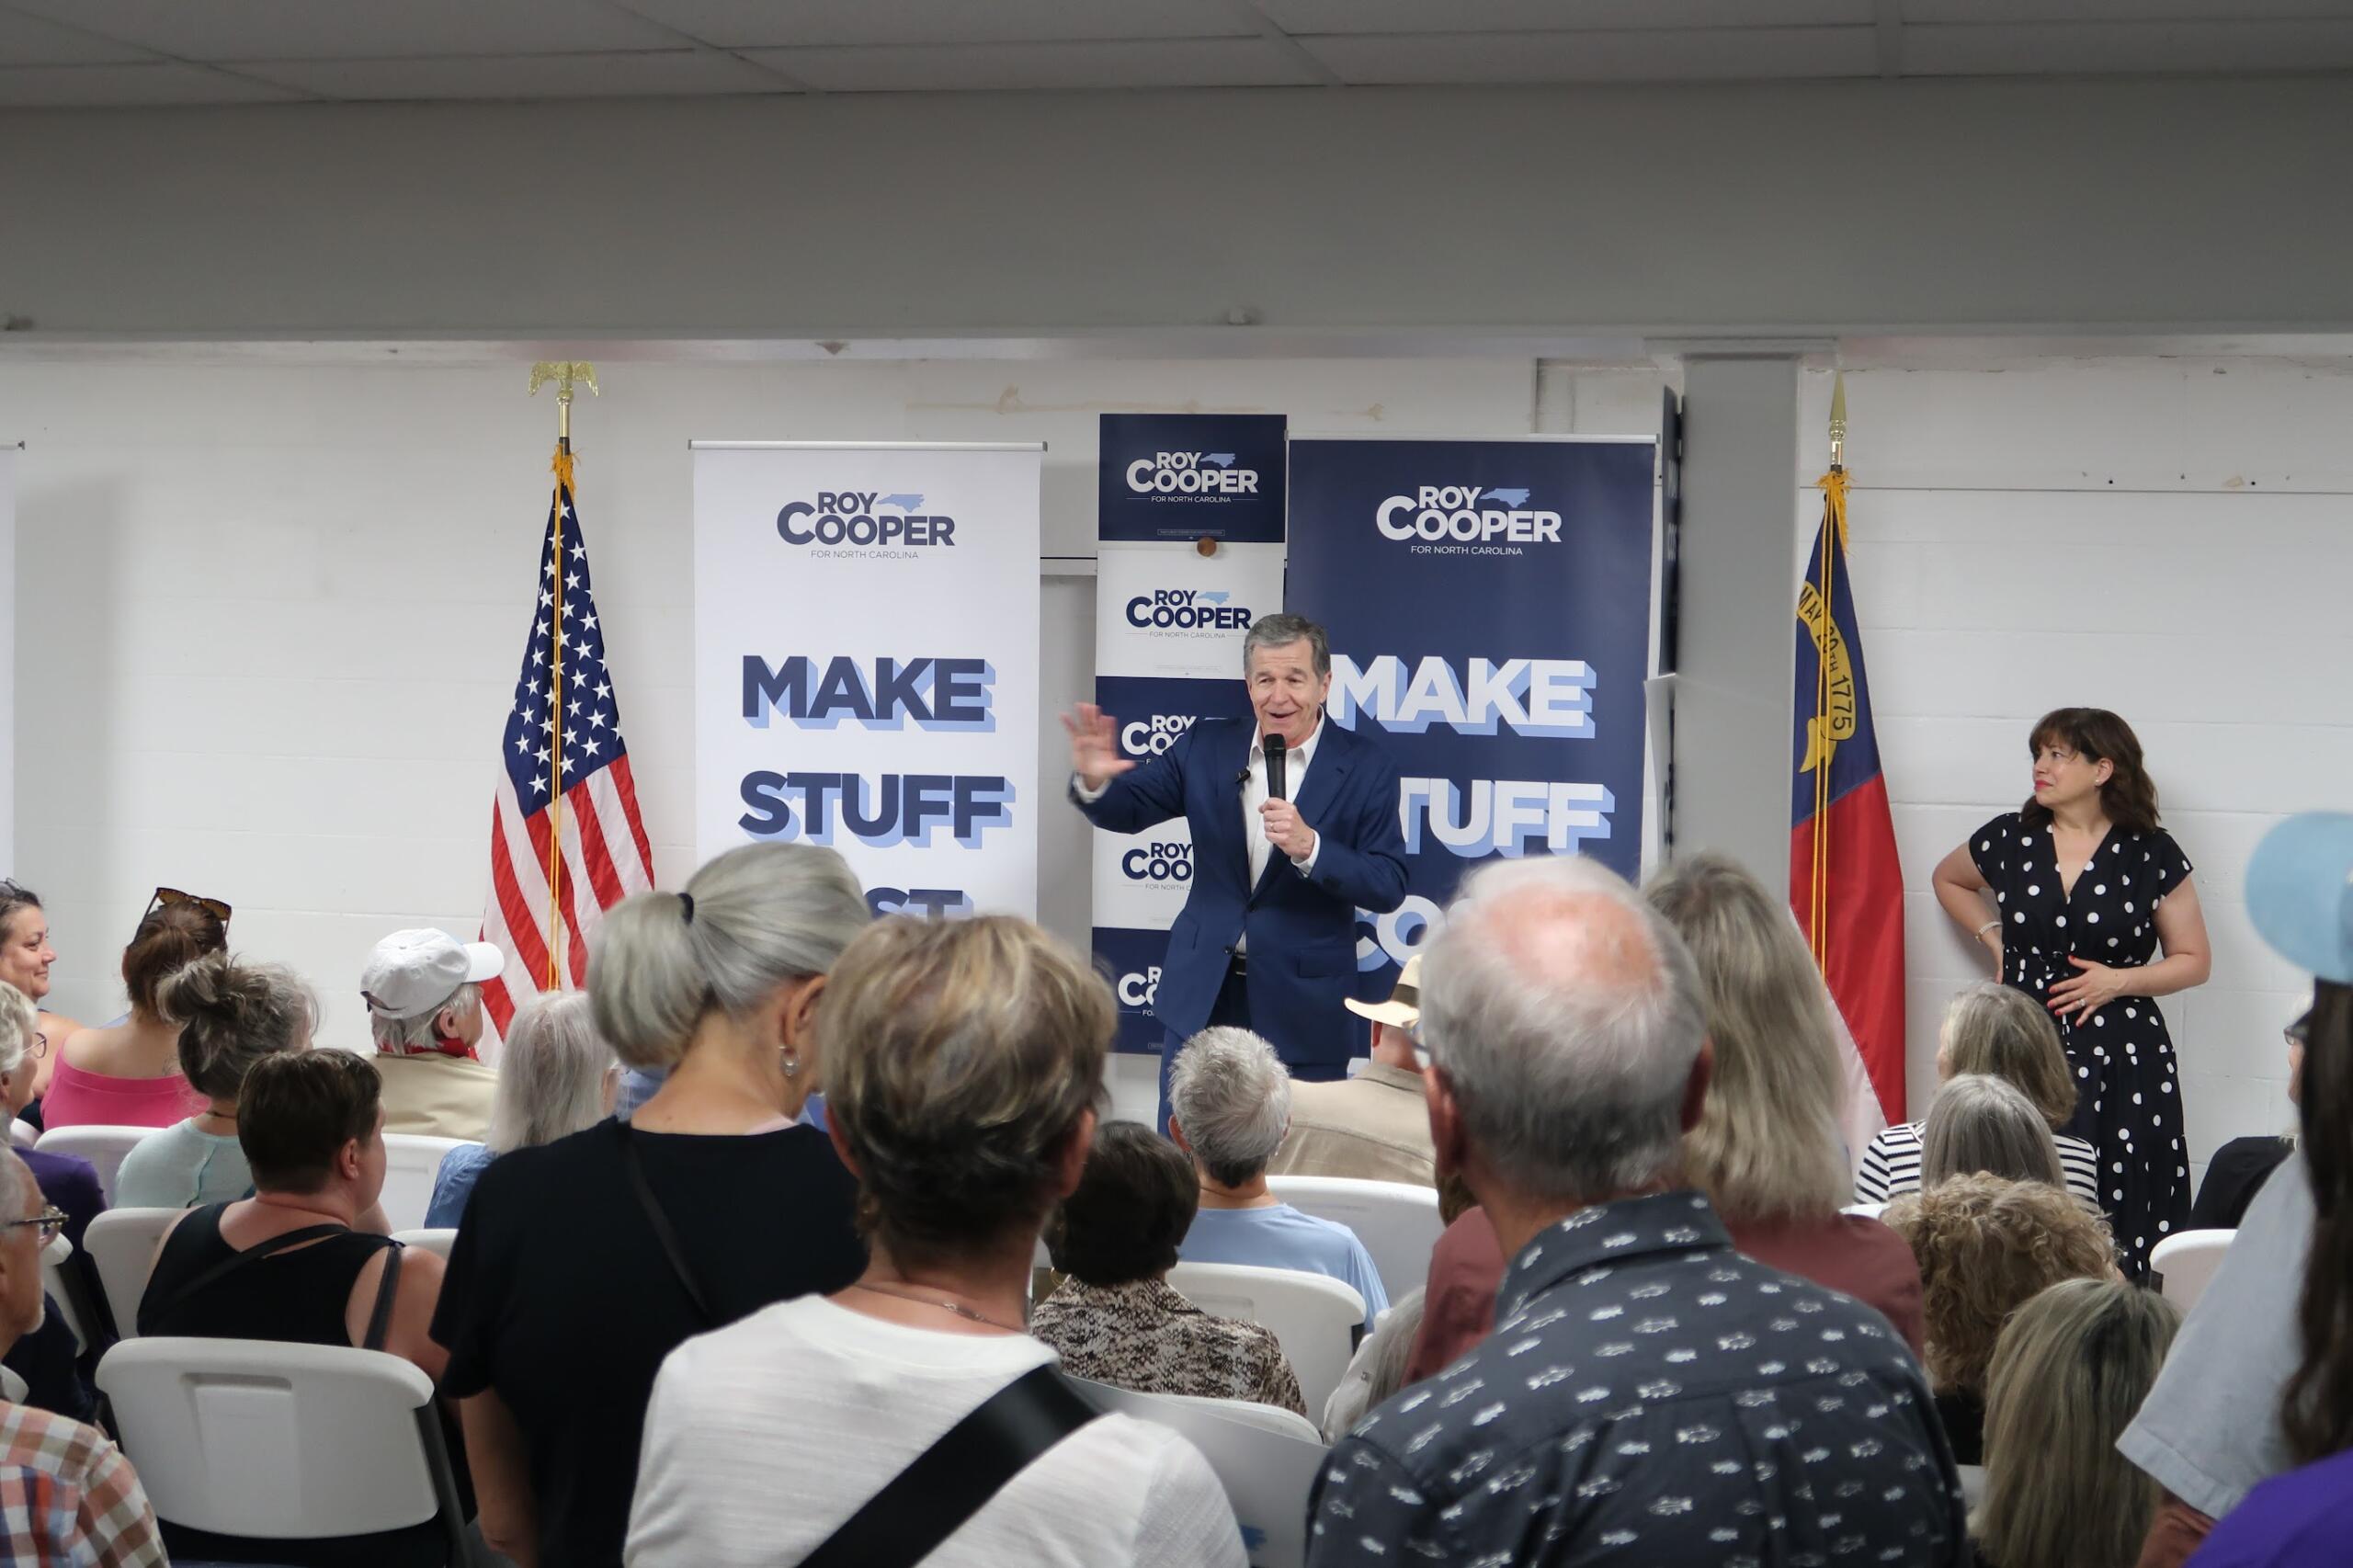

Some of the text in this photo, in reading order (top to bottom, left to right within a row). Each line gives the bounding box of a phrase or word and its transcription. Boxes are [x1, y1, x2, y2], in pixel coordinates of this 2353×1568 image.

[1156, 451, 1202, 470] ROY
[1126, 459, 1258, 494] COOPER
[817, 492, 879, 515] ROY
[1194, 495, 1232, 504] CAROLINA
[1418, 486, 1483, 509] ROY
[777, 501, 955, 546] COOPER
[1377, 495, 1562, 542] COOPER
[811, 550, 919, 560] FOR NORTH CAROLINA
[1411, 545, 1523, 555] FOR NORTH CAROLINA
[1154, 589, 1198, 607] ROY
[1126, 597, 1252, 630] COOPER
[1149, 631, 1164, 639] FOR
[1190, 631, 1226, 640] CAROLINA
[743, 655, 995, 733] MAKE
[1326, 653, 1597, 739] MAKE
[1831, 674, 1853, 731] 1775
[1152, 714, 1198, 733] ROY
[738, 770, 1016, 849] STUFF
[1398, 777, 1615, 858] TUFF
[1151, 842, 1193, 858] ROY
[1122, 848, 1192, 881] COO
